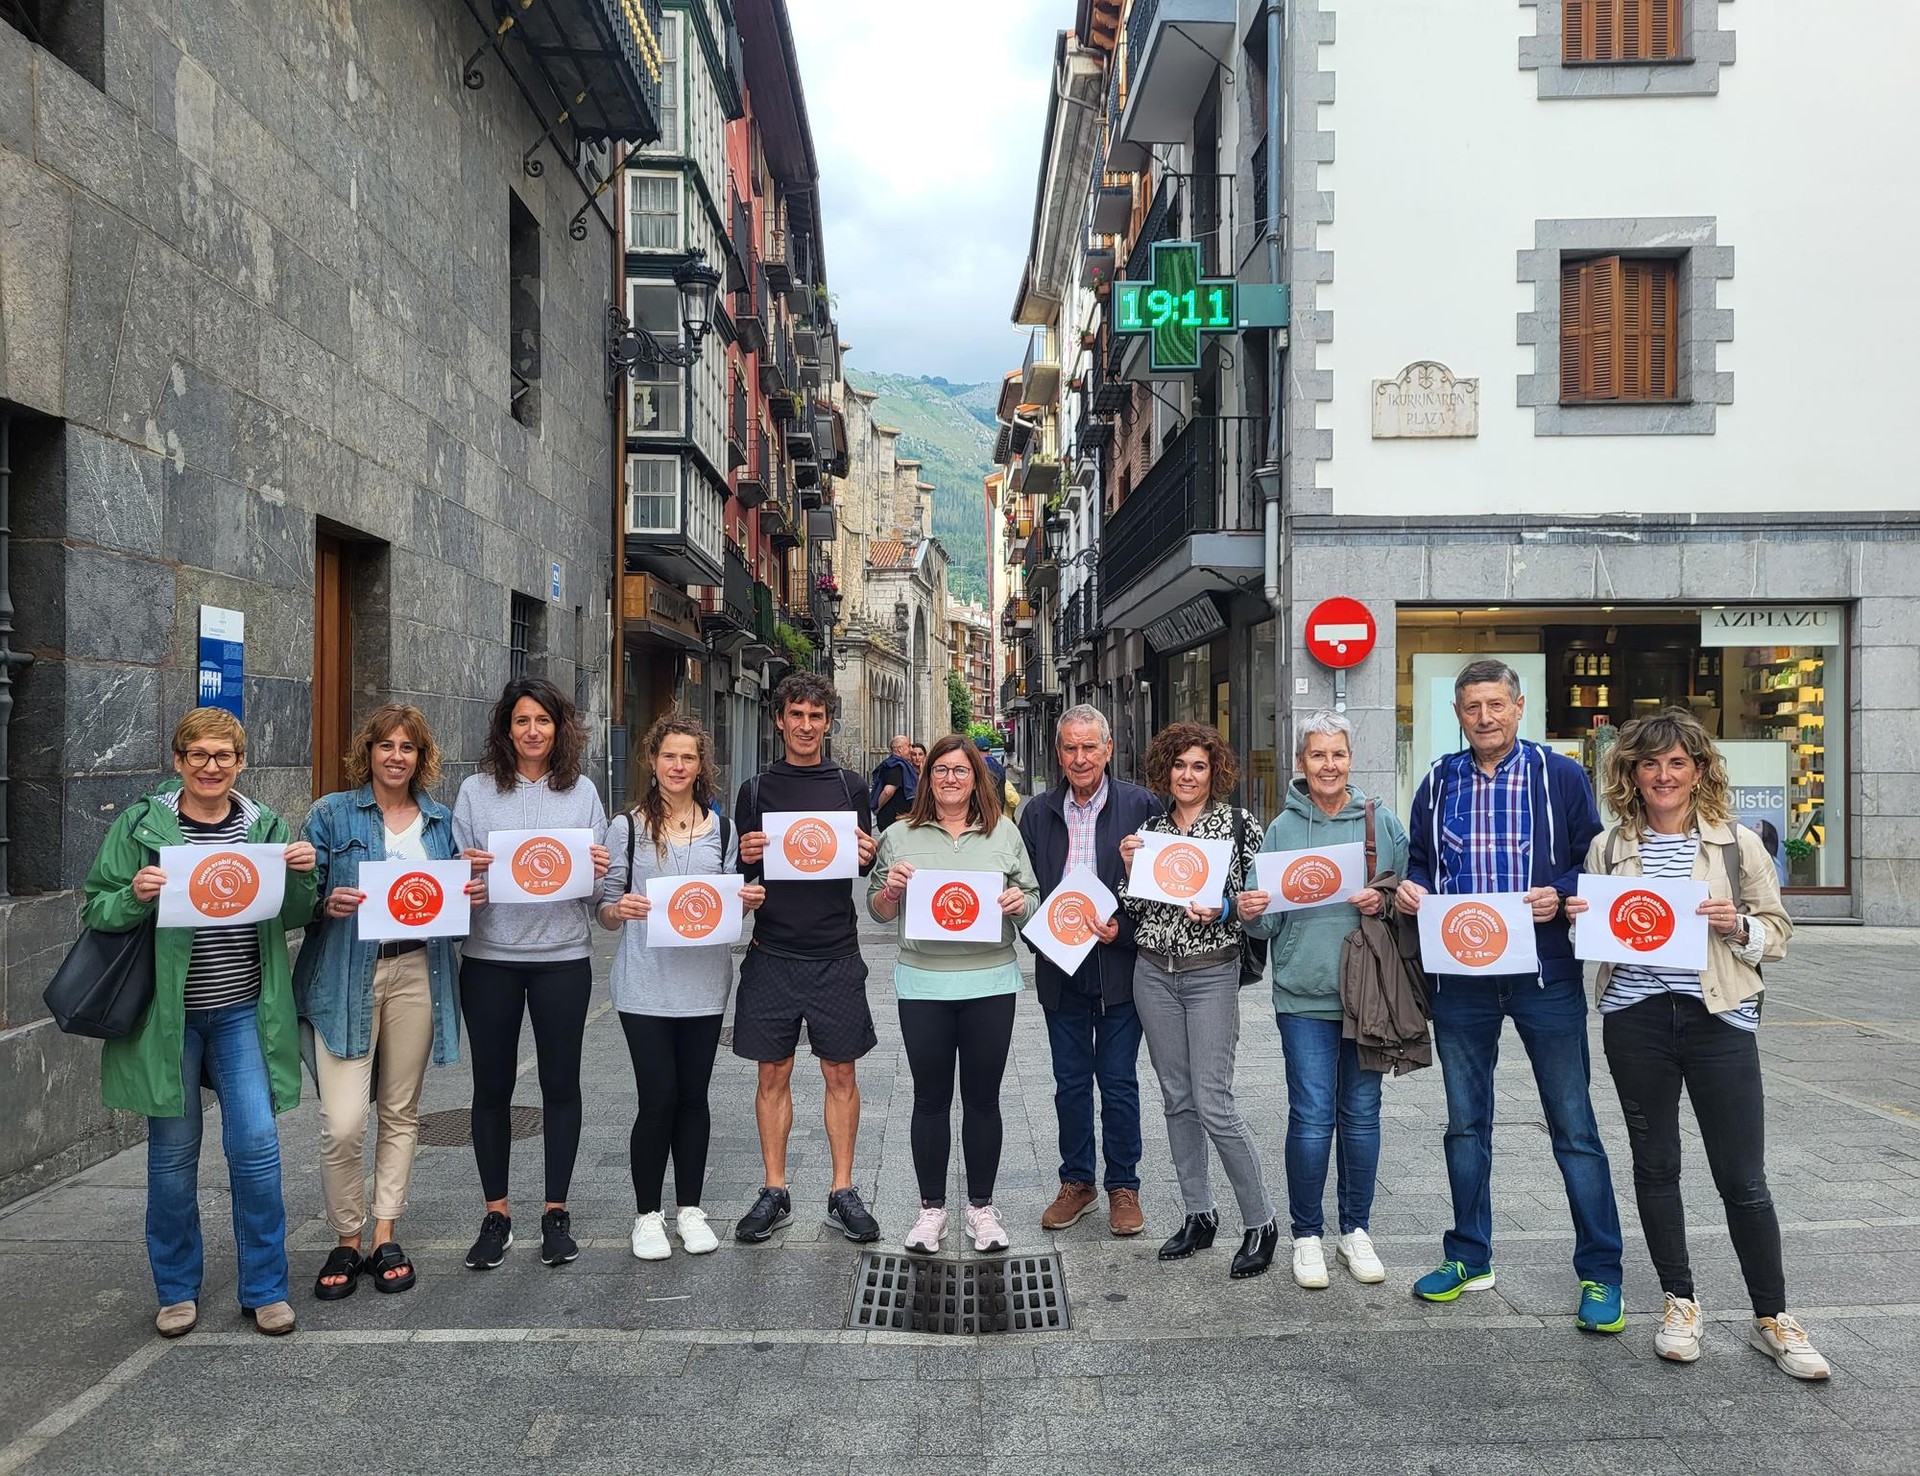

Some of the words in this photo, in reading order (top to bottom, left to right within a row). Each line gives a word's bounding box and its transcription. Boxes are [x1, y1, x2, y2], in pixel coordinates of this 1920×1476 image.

[1122, 289, 1230, 326] 19:11
[1406, 412, 1445, 425] PLAZA
[1713, 611, 1829, 627] AZPIAZU
